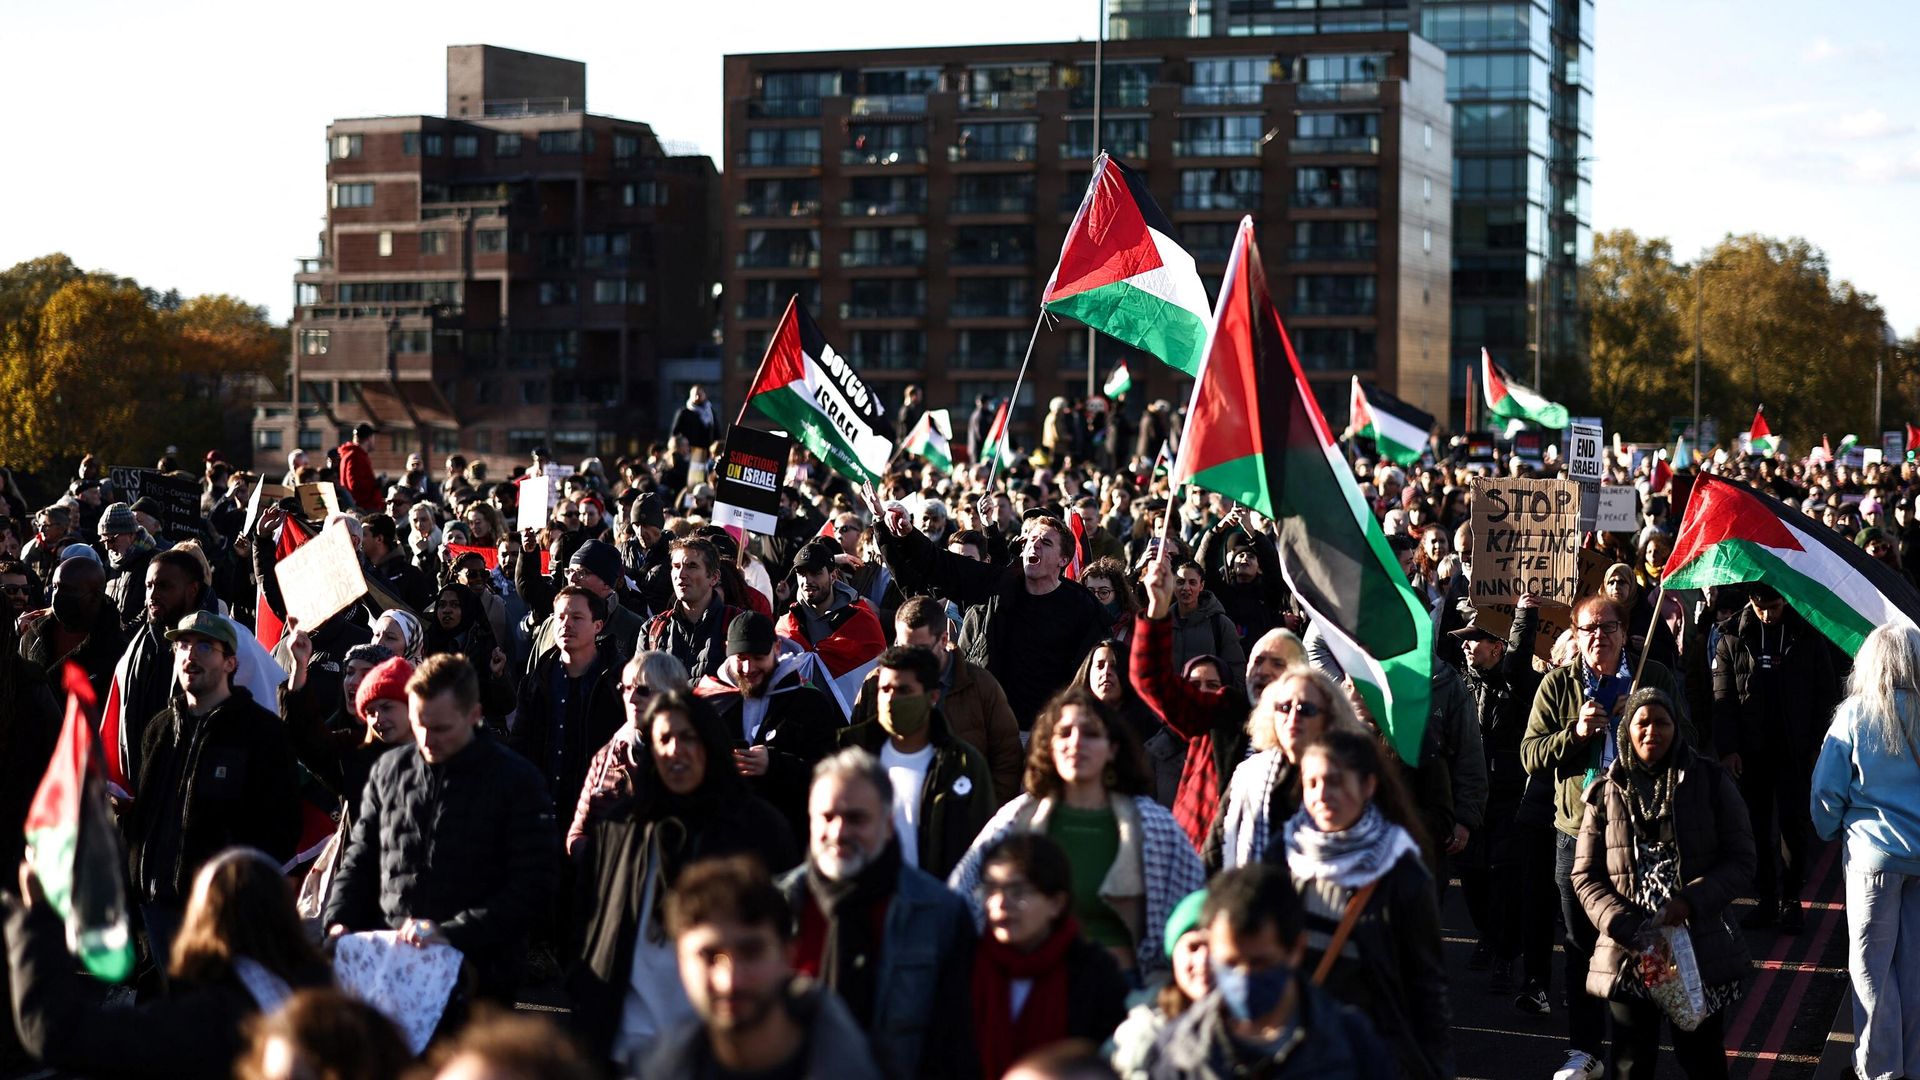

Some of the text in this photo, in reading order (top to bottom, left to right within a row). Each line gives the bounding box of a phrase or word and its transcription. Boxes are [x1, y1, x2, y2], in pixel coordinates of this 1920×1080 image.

[820, 343, 882, 416] BOYCO
[1576, 438, 1595, 458] END
[729, 450, 779, 474] SANCTIONS
[1571, 459, 1599, 476] ISRAELI
[726, 463, 777, 489] ON ISRAEL
[145, 481, 165, 497] PRO
[1582, 481, 1600, 494] THEID
[1486, 488, 1572, 523] STOP
[1485, 528, 1576, 554] KILLING
[1495, 555, 1550, 572] THE
[1475, 576, 1577, 597] INNOCENT
